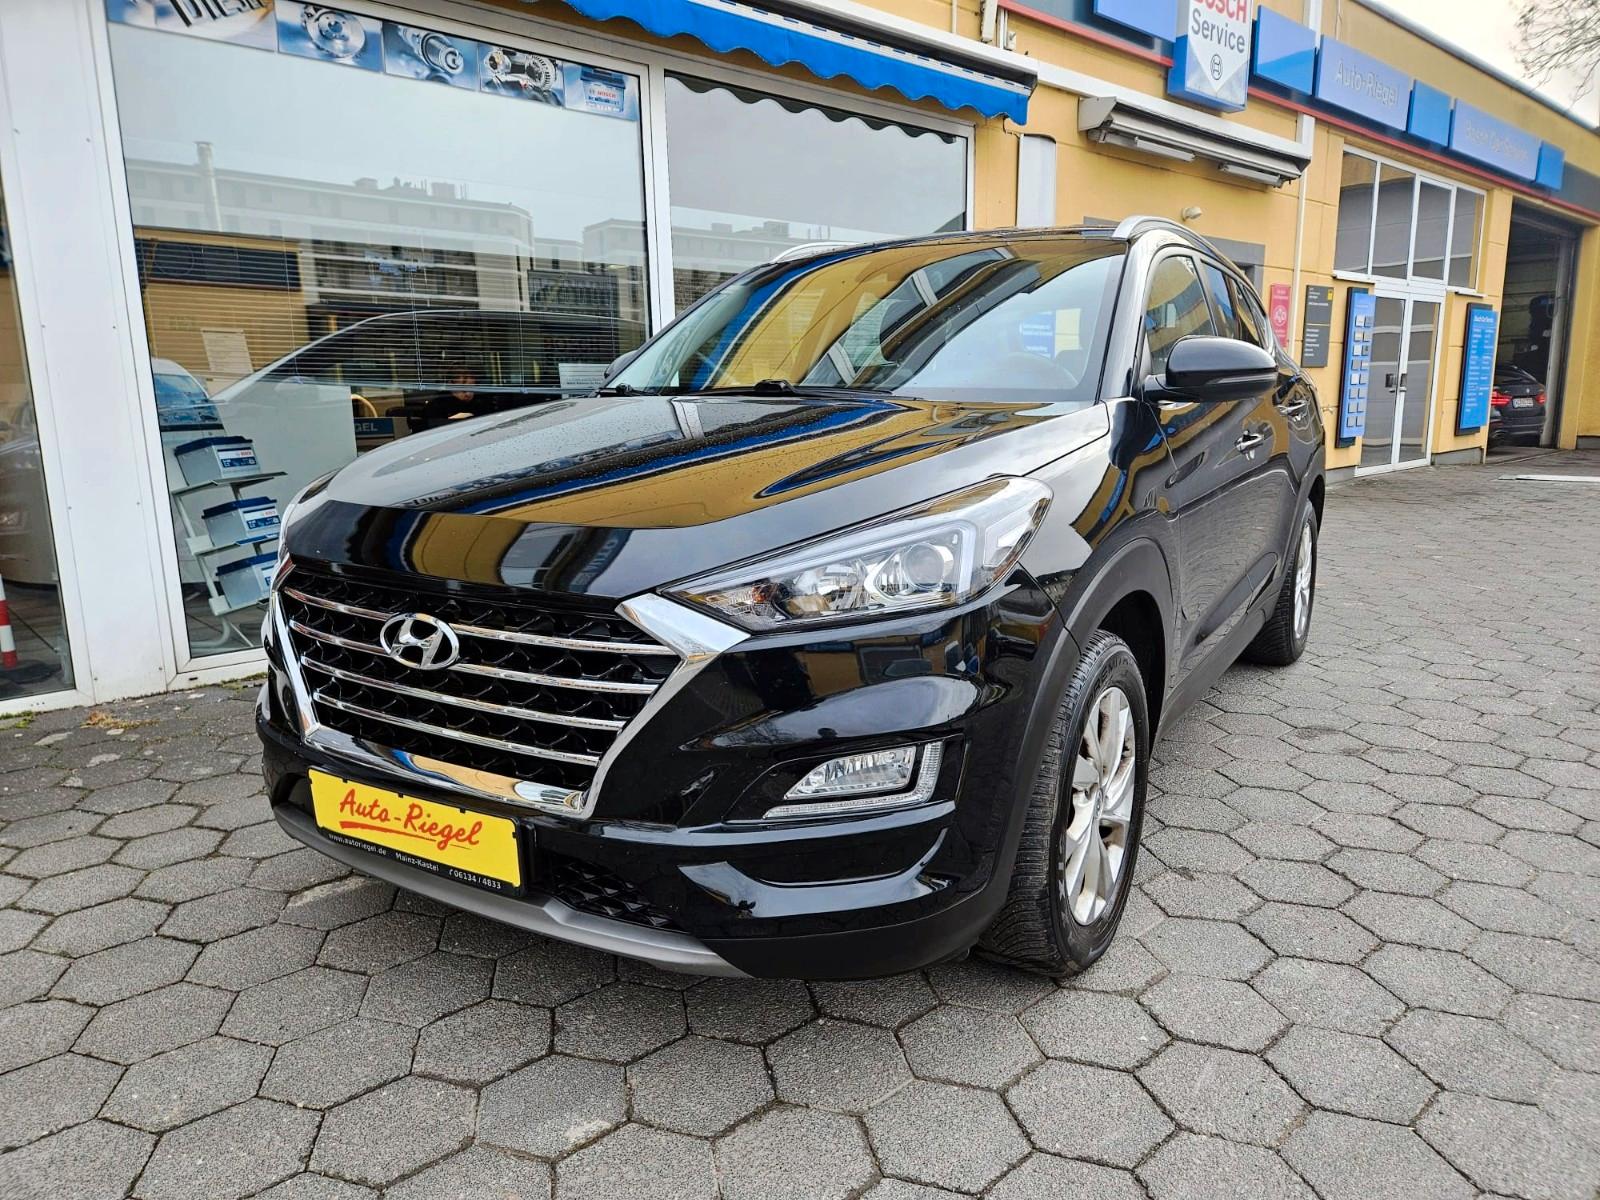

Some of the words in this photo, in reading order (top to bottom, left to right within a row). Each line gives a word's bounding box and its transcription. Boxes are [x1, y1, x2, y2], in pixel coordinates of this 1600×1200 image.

[1191, 7, 1246, 54] Service
[1336, 58, 1400, 107] Auto-Riegel
[339, 788, 483, 851] Auto-Riegel
[328, 833, 387, 856] www.autoriegel.de
[395, 852, 440, 872] Mainz-Kastel
[482, 878, 501, 889] 4833
